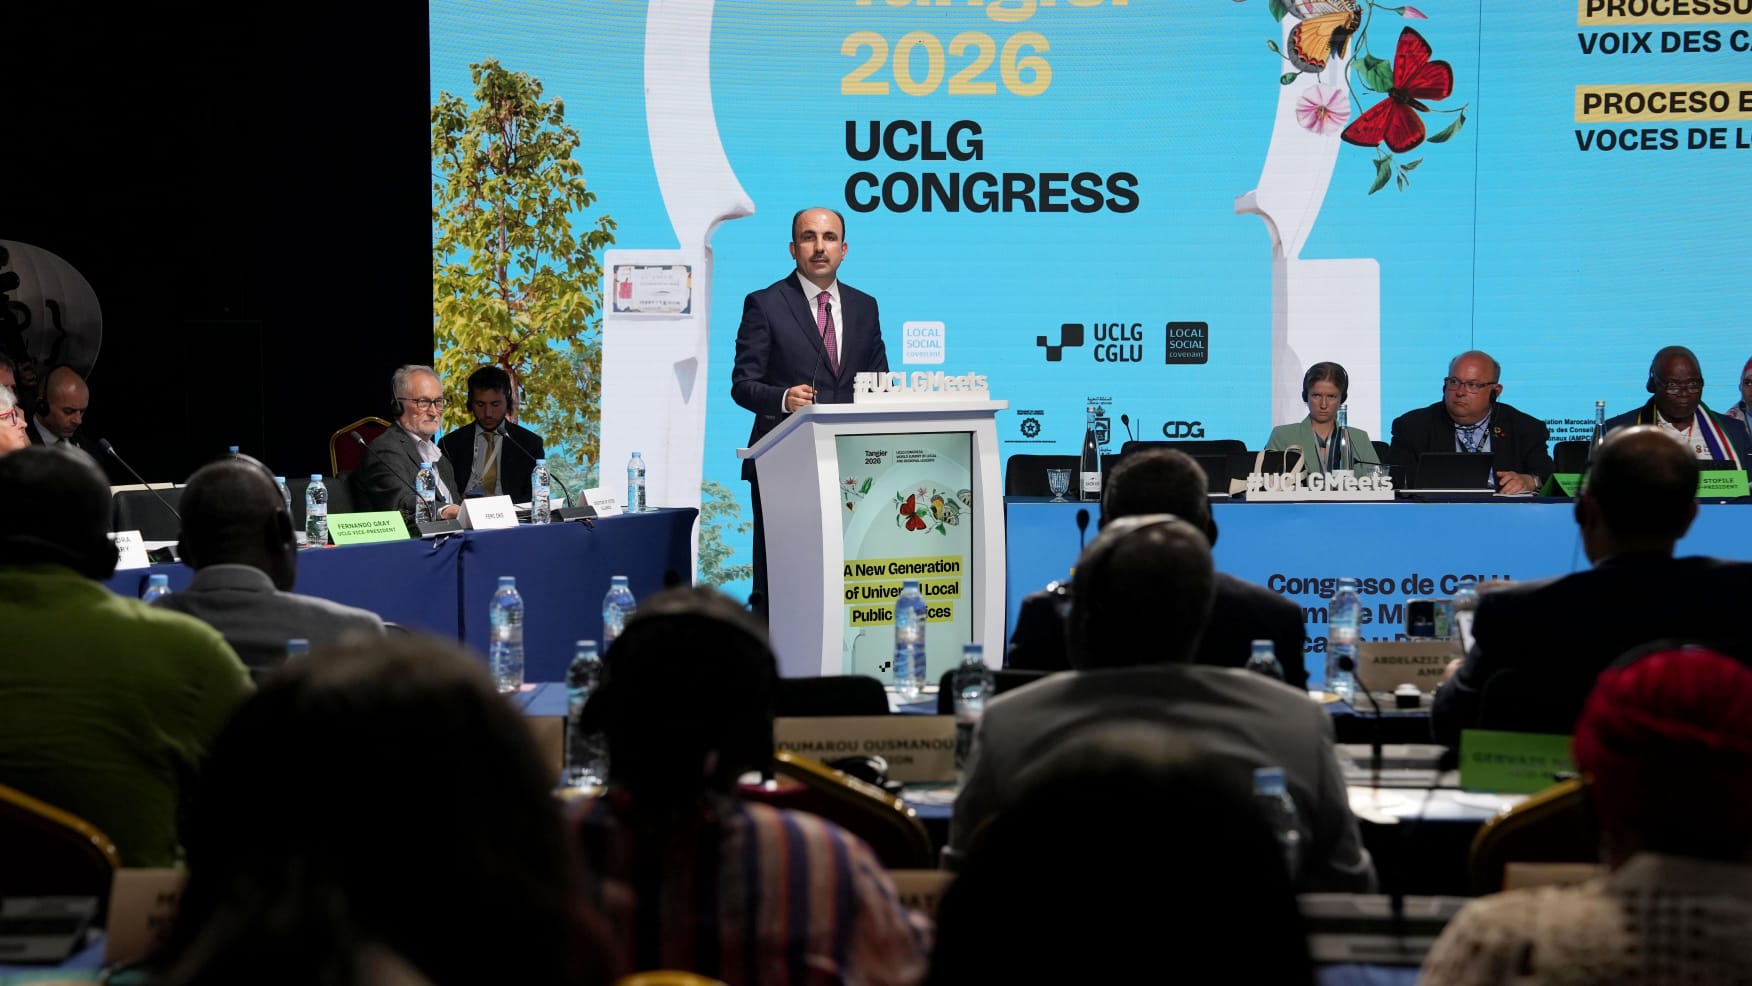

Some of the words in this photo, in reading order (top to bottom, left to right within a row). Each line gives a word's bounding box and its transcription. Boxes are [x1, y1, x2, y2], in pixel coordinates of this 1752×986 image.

[1577, 31, 1653, 54] VOIX
[1661, 30, 1722, 53] DES
[1730, 29, 1752, 52] C
[840, 31, 1052, 96] 2026
[1583, 90, 1730, 115] PROCESO
[845, 120, 984, 162] UCLG
[1575, 128, 1679, 152] VOCES
[1687, 127, 1727, 150] DE
[1736, 127, 1752, 149] L
[844, 171, 1140, 214] CONGRESS
[906, 328, 941, 337] LOCAL
[1094, 323, 1143, 342] UCLG
[1169, 329, 1205, 338] LOCAL
[906, 339, 942, 349] SOCIAL
[1094, 344, 1143, 363] CGLU
[1169, 340, 1205, 349] SOCIAL
[853, 370, 989, 393] #UCLGMeets
[1162, 420, 1205, 439] CDG
[865, 449, 888, 458] Tangier
[865, 457, 882, 465] 2026
[1246, 471, 1394, 492] #UCLGMeets
[337, 521, 372, 530] FERNANDO
[373, 519, 390, 527] GRAY
[844, 565, 853, 577] A
[856, 563, 885, 576] New
[888, 559, 960, 575] Generation
[845, 586, 859, 600] of
[925, 581, 959, 596] Local
[1400, 573, 1434, 595] de
[852, 607, 892, 623] Public
[863, 738, 954, 751] OUSMANOU
